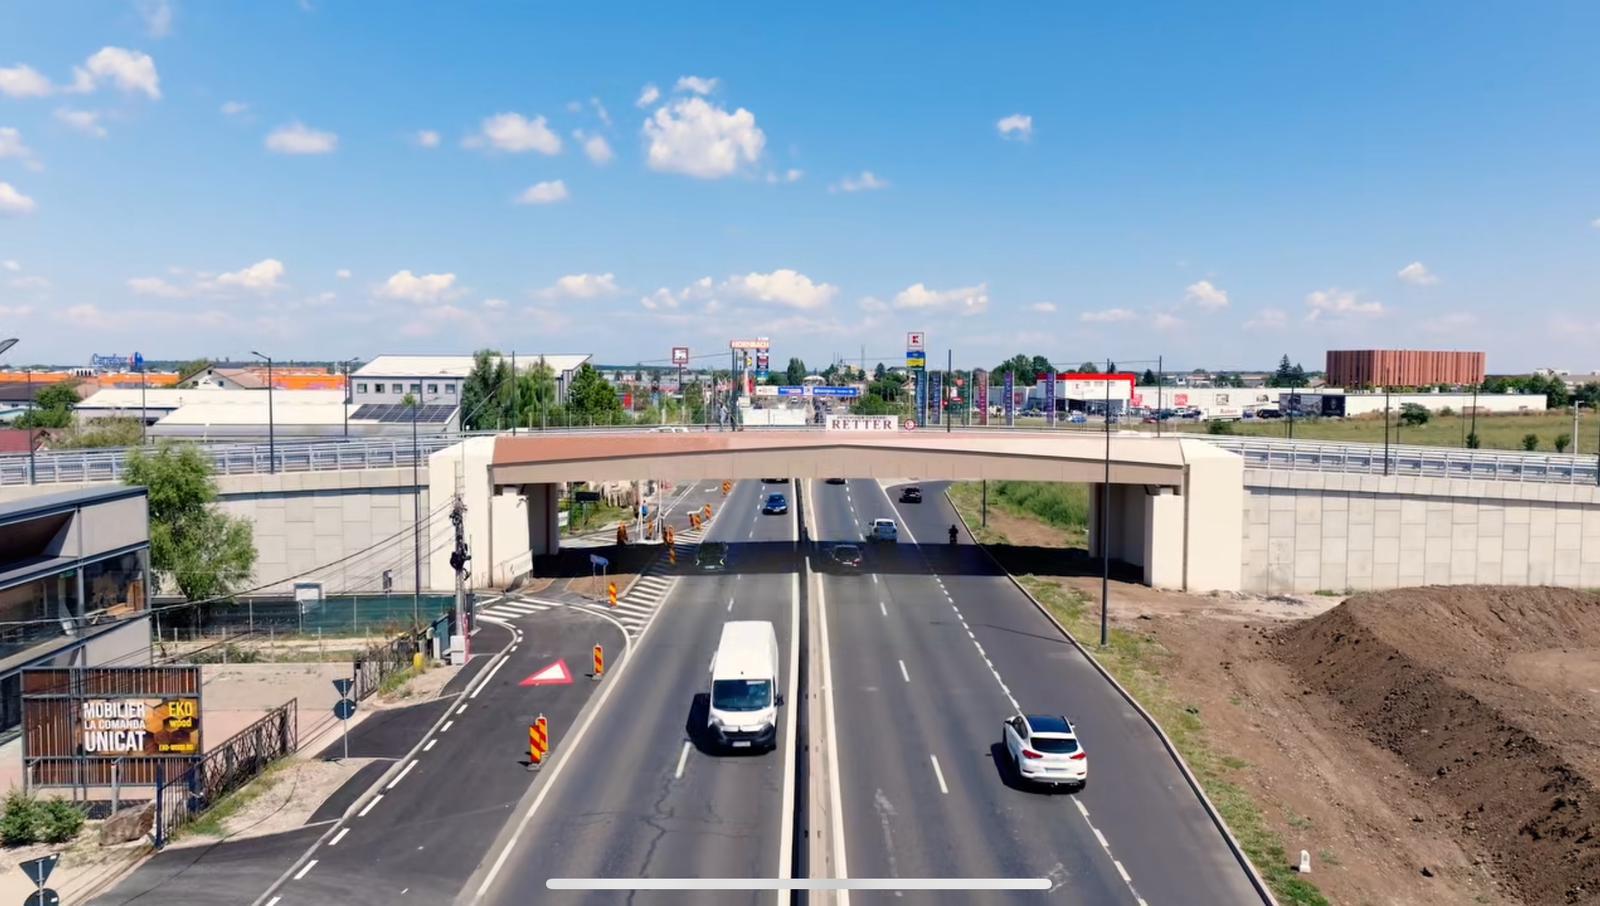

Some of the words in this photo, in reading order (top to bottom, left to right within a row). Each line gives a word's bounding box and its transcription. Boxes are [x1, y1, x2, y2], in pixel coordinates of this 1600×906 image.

[832, 419, 892, 429] RETTER
[83, 702, 146, 718] MOBILIER
[168, 702, 193, 716] EKO
[84, 720, 96, 729] LA
[98, 719, 146, 729] COMANDA
[169, 717, 192, 728] wood
[84, 731, 146, 752] UNICAT
